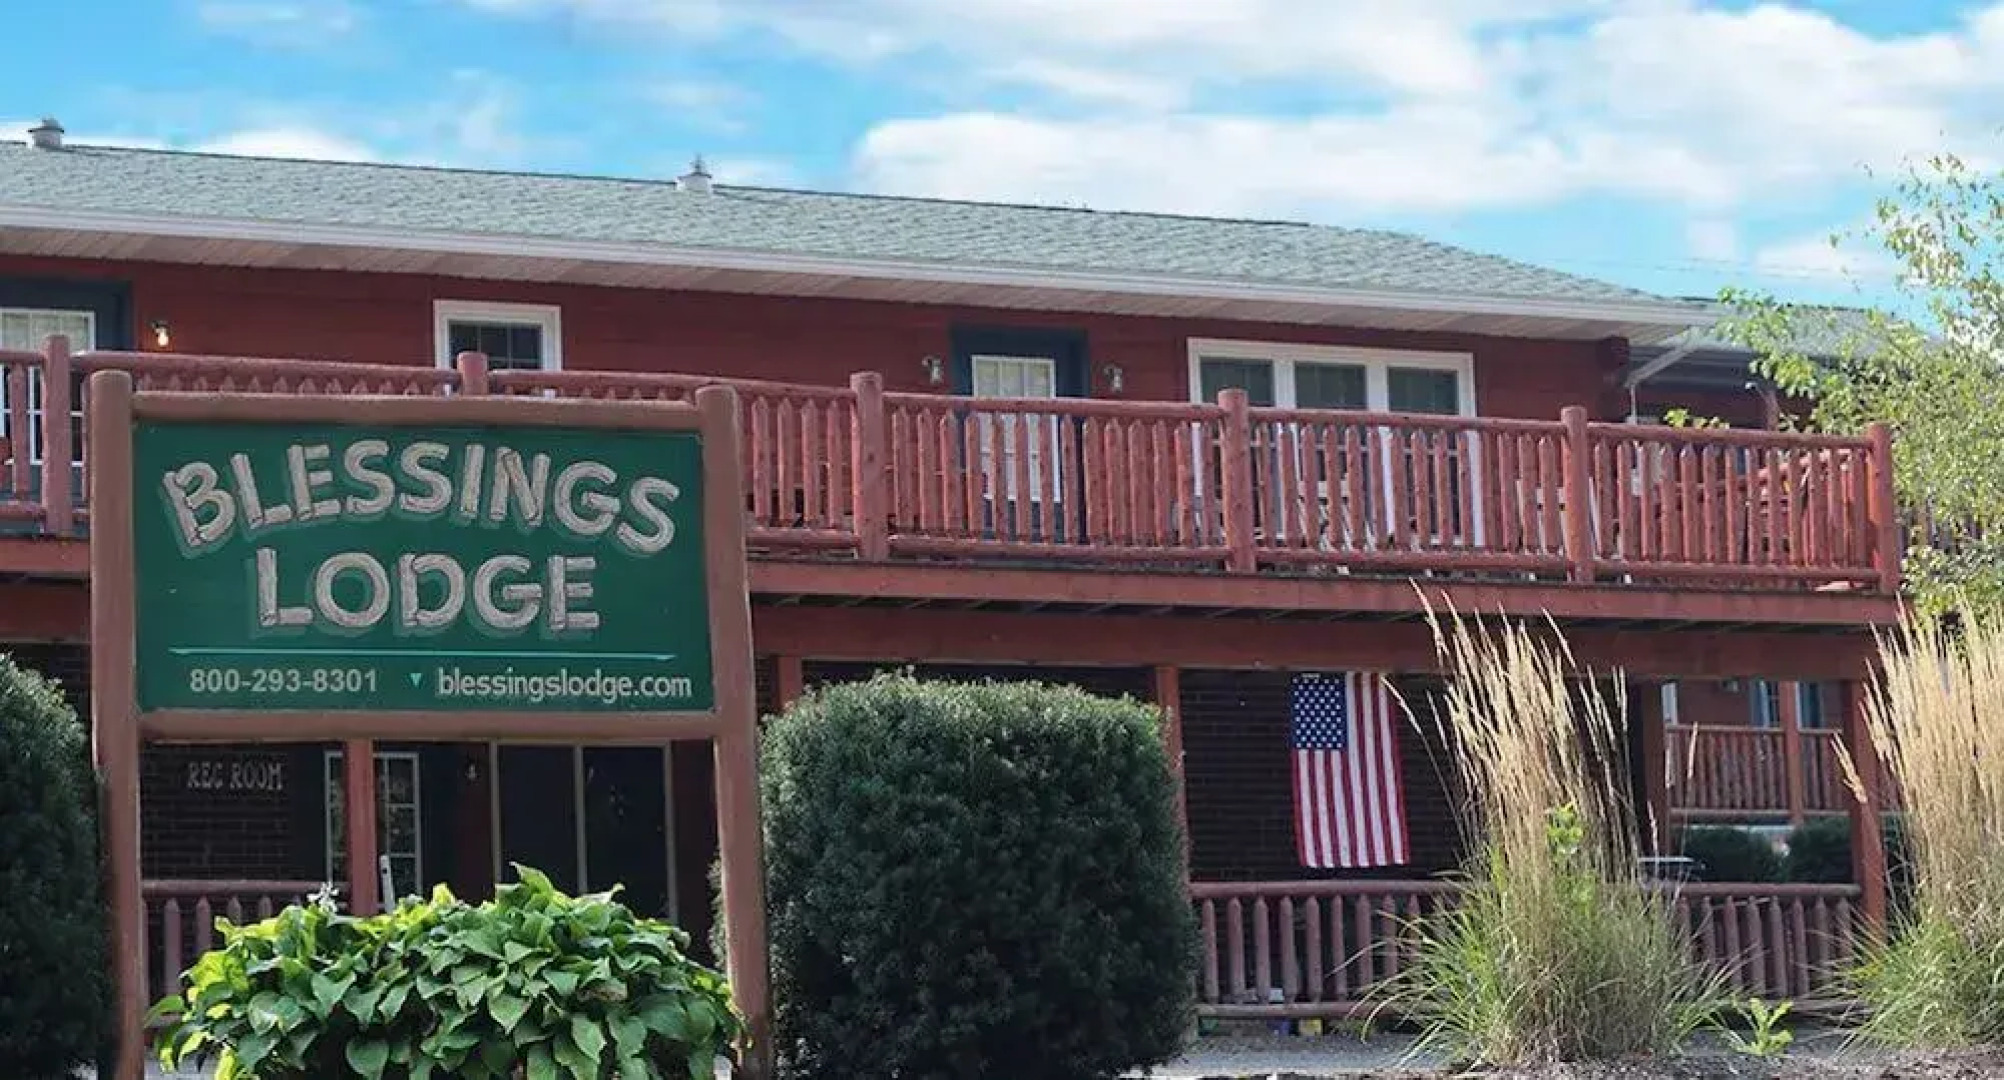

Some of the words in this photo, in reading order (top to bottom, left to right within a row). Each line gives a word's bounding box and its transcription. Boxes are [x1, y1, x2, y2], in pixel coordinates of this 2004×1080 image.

[163, 440, 680, 553] BLESSINGS
[257, 547, 600, 631] LODGE
[189, 668, 377, 692] 800-293-8301
[438, 667, 692, 703] blessingslodge.com
[187, 762, 223, 790] REC
[230, 761, 283, 790] ROOM
